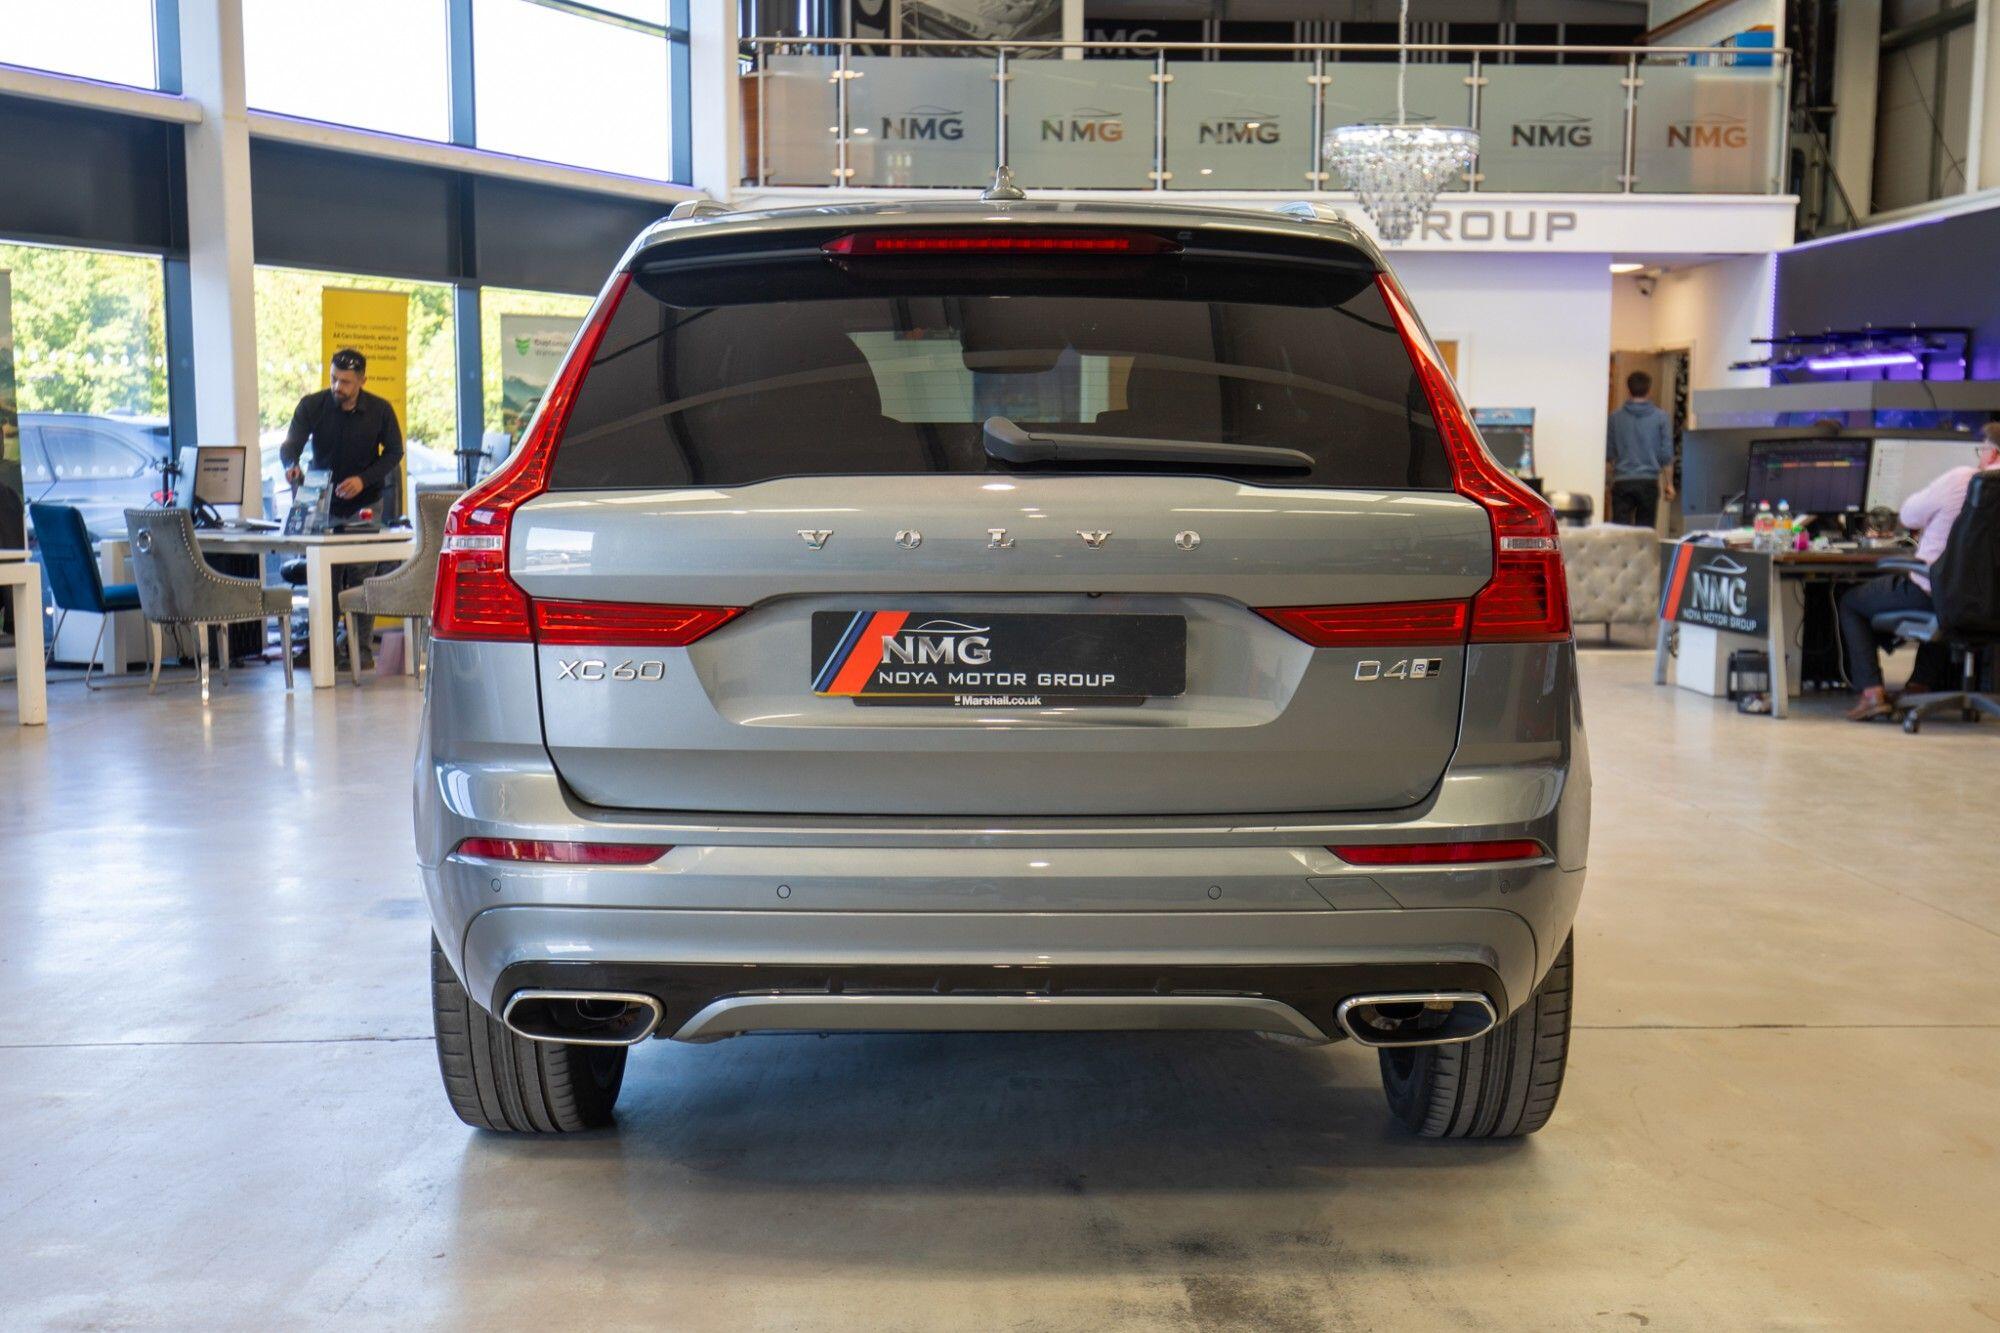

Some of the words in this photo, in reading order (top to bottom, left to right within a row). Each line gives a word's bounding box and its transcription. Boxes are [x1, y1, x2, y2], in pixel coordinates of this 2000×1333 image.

[881, 117, 964, 140] NMG
[1041, 119, 1124, 143] NMG
[1199, 121, 1281, 145] NMG
[1511, 124, 1593, 148] NMG
[1668, 126, 1748, 149] NMG
[797, 528, 1202, 551] VOLVO
[1691, 571, 1748, 617] NMG
[881, 635, 992, 665] NMG
[879, 671, 938, 684] NOYA
[948, 672, 1027, 686] MOTOR
[1037, 672, 1116, 687] GROUP
[1354, 660, 1408, 681] D4
[962, 694, 1042, 706] Marshall.co.uk
